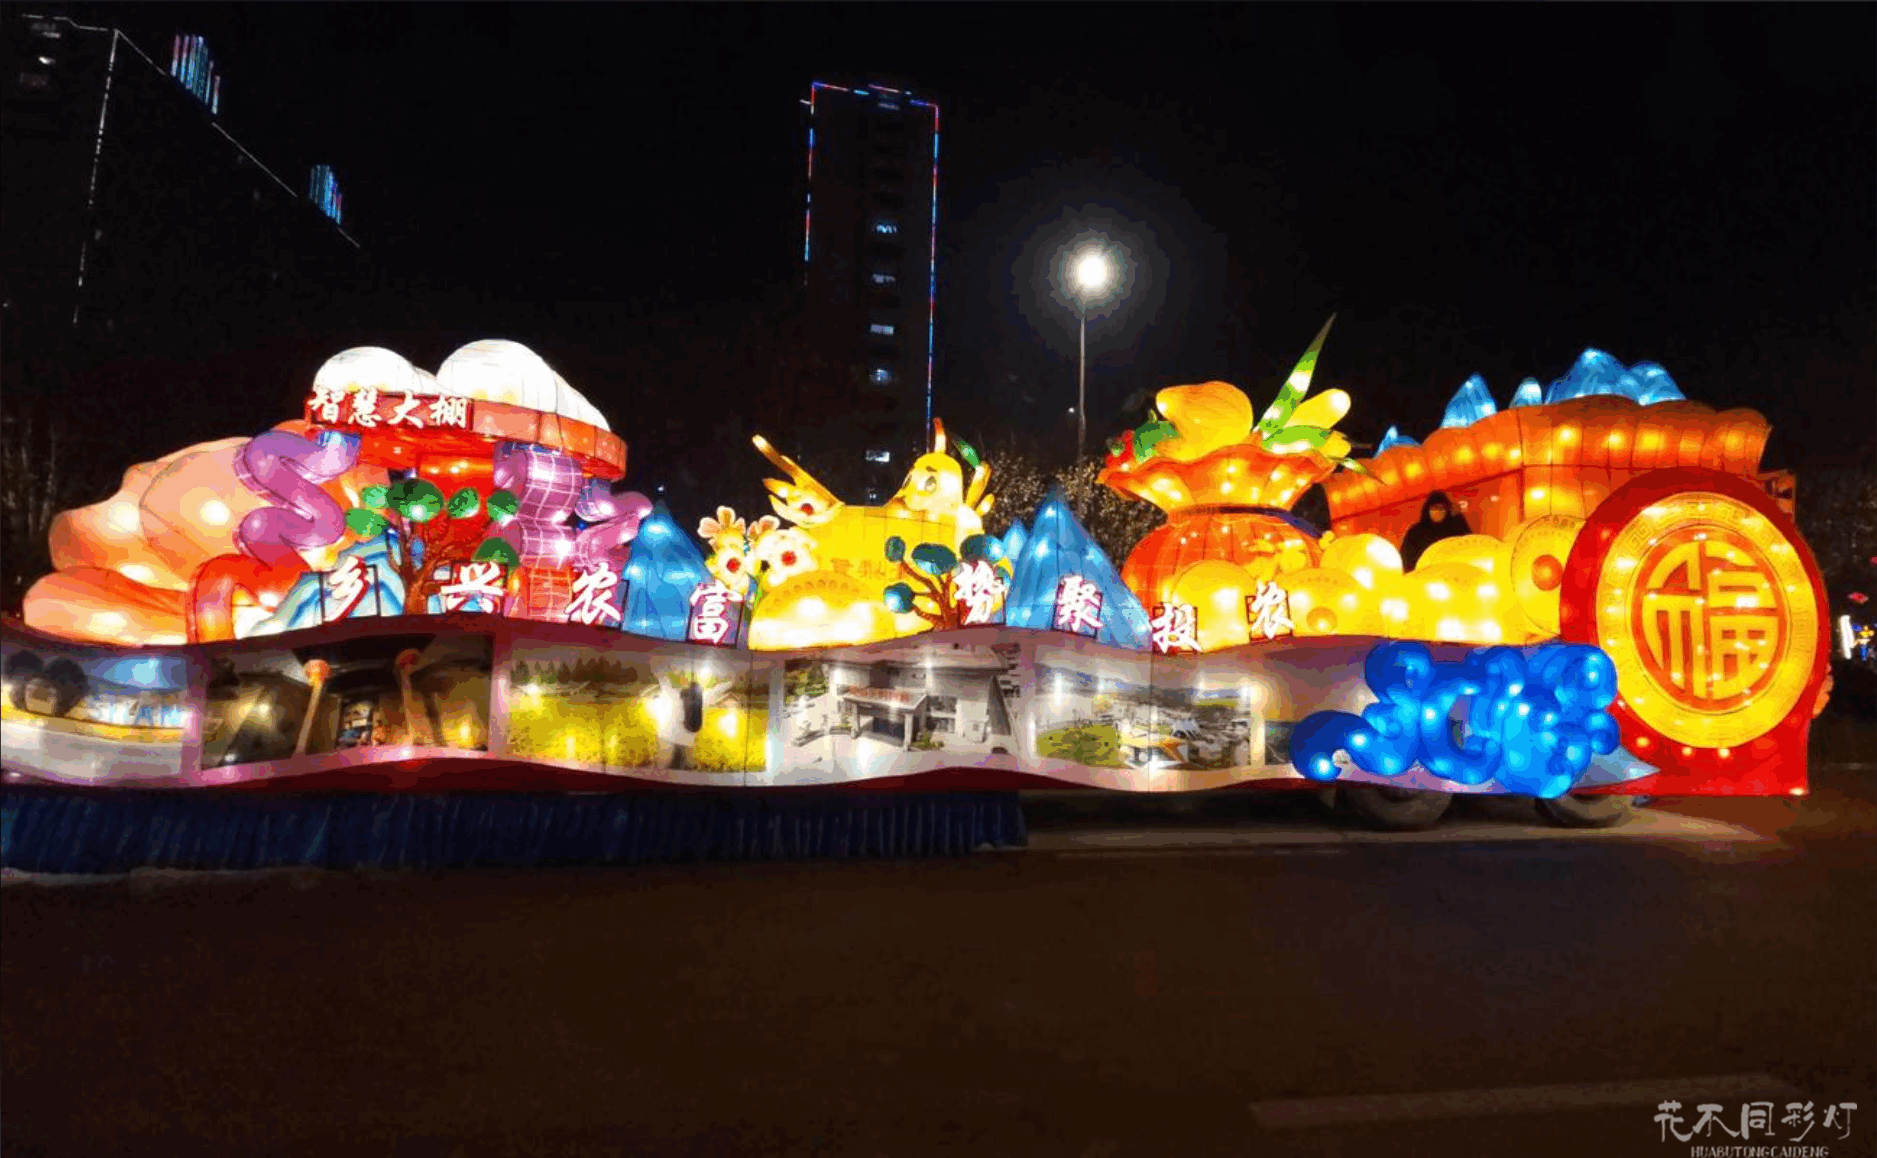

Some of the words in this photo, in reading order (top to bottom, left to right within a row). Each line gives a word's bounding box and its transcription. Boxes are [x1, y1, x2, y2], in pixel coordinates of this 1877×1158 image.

[308, 388, 467, 428] 智慧大棚
[1641, 531, 1780, 700] 福
